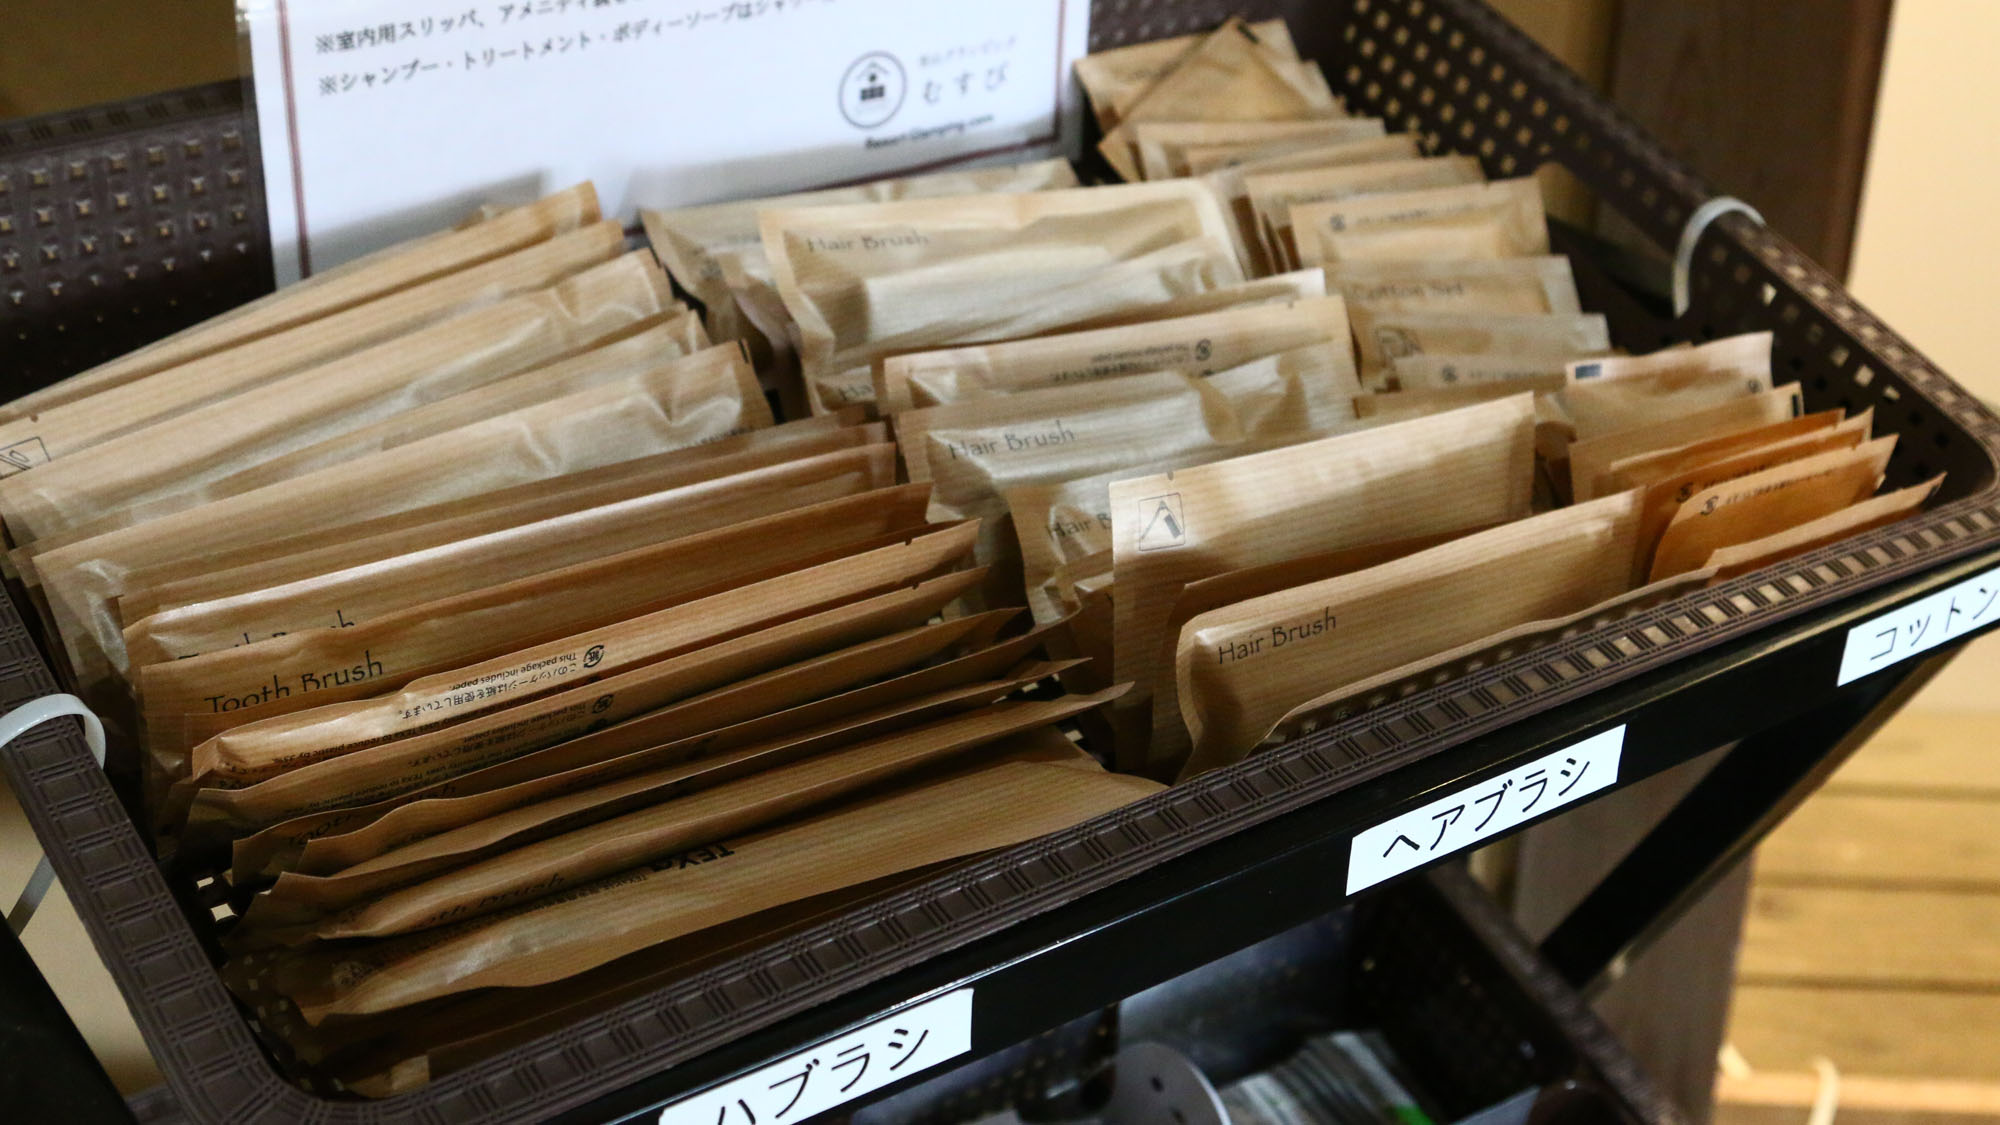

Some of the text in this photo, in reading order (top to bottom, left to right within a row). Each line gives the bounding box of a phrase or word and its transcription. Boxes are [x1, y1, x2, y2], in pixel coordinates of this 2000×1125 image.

[807, 229, 929, 252] Hair Brush
[948, 419, 1075, 460] Hair Brush
[1045, 518, 1091, 540] Hair
[1218, 605, 1337, 665] Hair Brush
[1870, 587, 1999, 661] コットン
[204, 649, 383, 713] Tooth Brush
[480, 668, 520, 685] includes
[520, 656, 558, 674] package
[559, 652, 577, 663] This
[399, 662, 577, 720] このパッケージは紙を使用しています。
[1383, 757, 1590, 858] ヘアブラシ
[717, 1028, 929, 1125] ハブラシ
